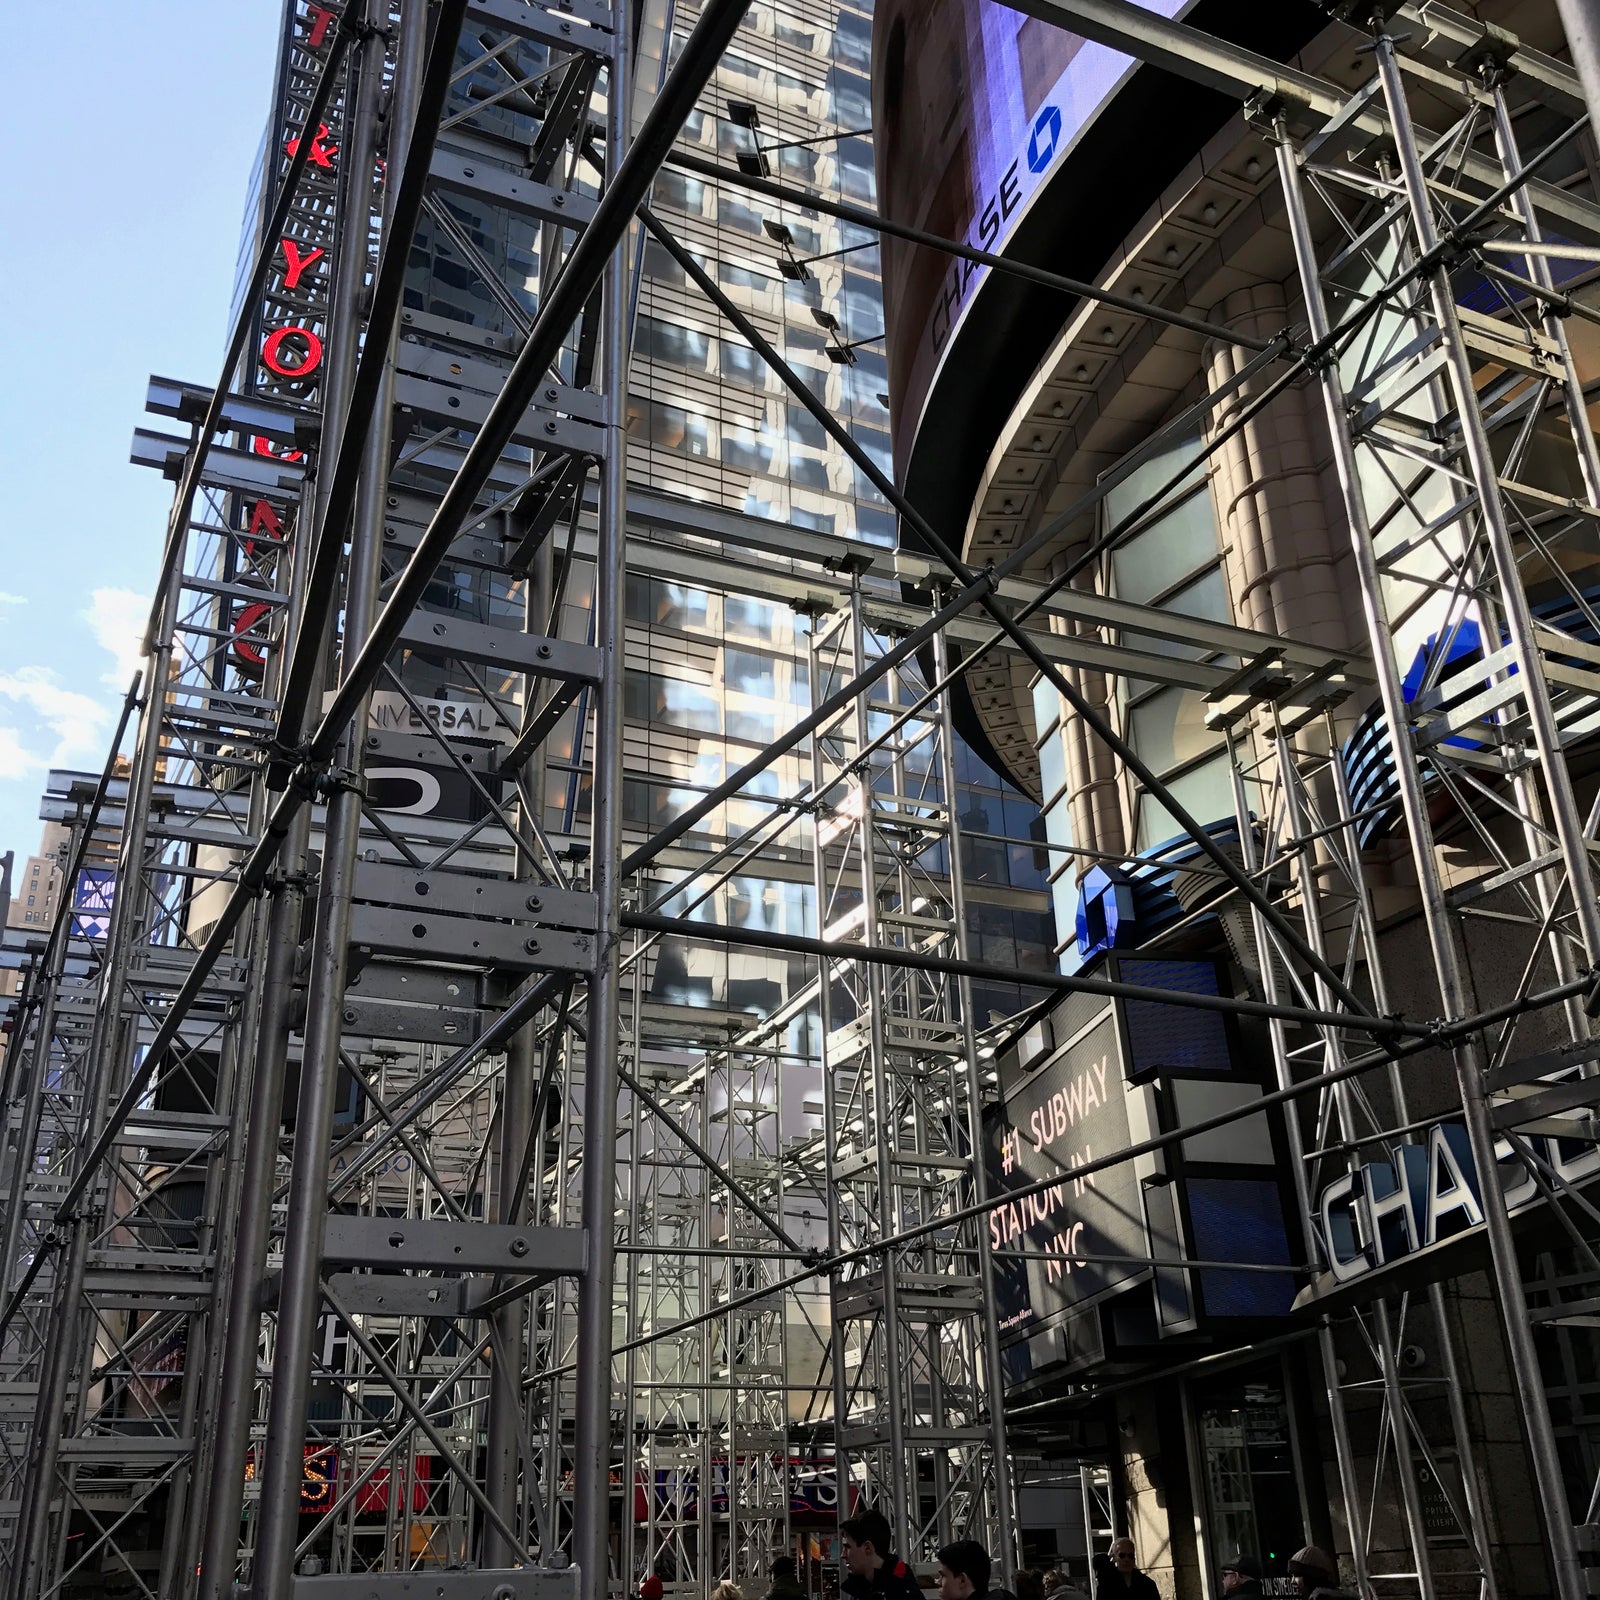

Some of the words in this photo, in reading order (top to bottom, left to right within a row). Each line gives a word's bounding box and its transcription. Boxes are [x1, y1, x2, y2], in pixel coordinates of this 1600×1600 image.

[931, 157, 1022, 355] CHASE
[369, 704, 490, 731] NIVERSAL
[1001, 1126, 1022, 1176] #1
[1030, 1055, 1107, 1153] SUBWAY
[1070, 1144, 1095, 1198] IN
[1044, 1221, 1087, 1284] NYC
